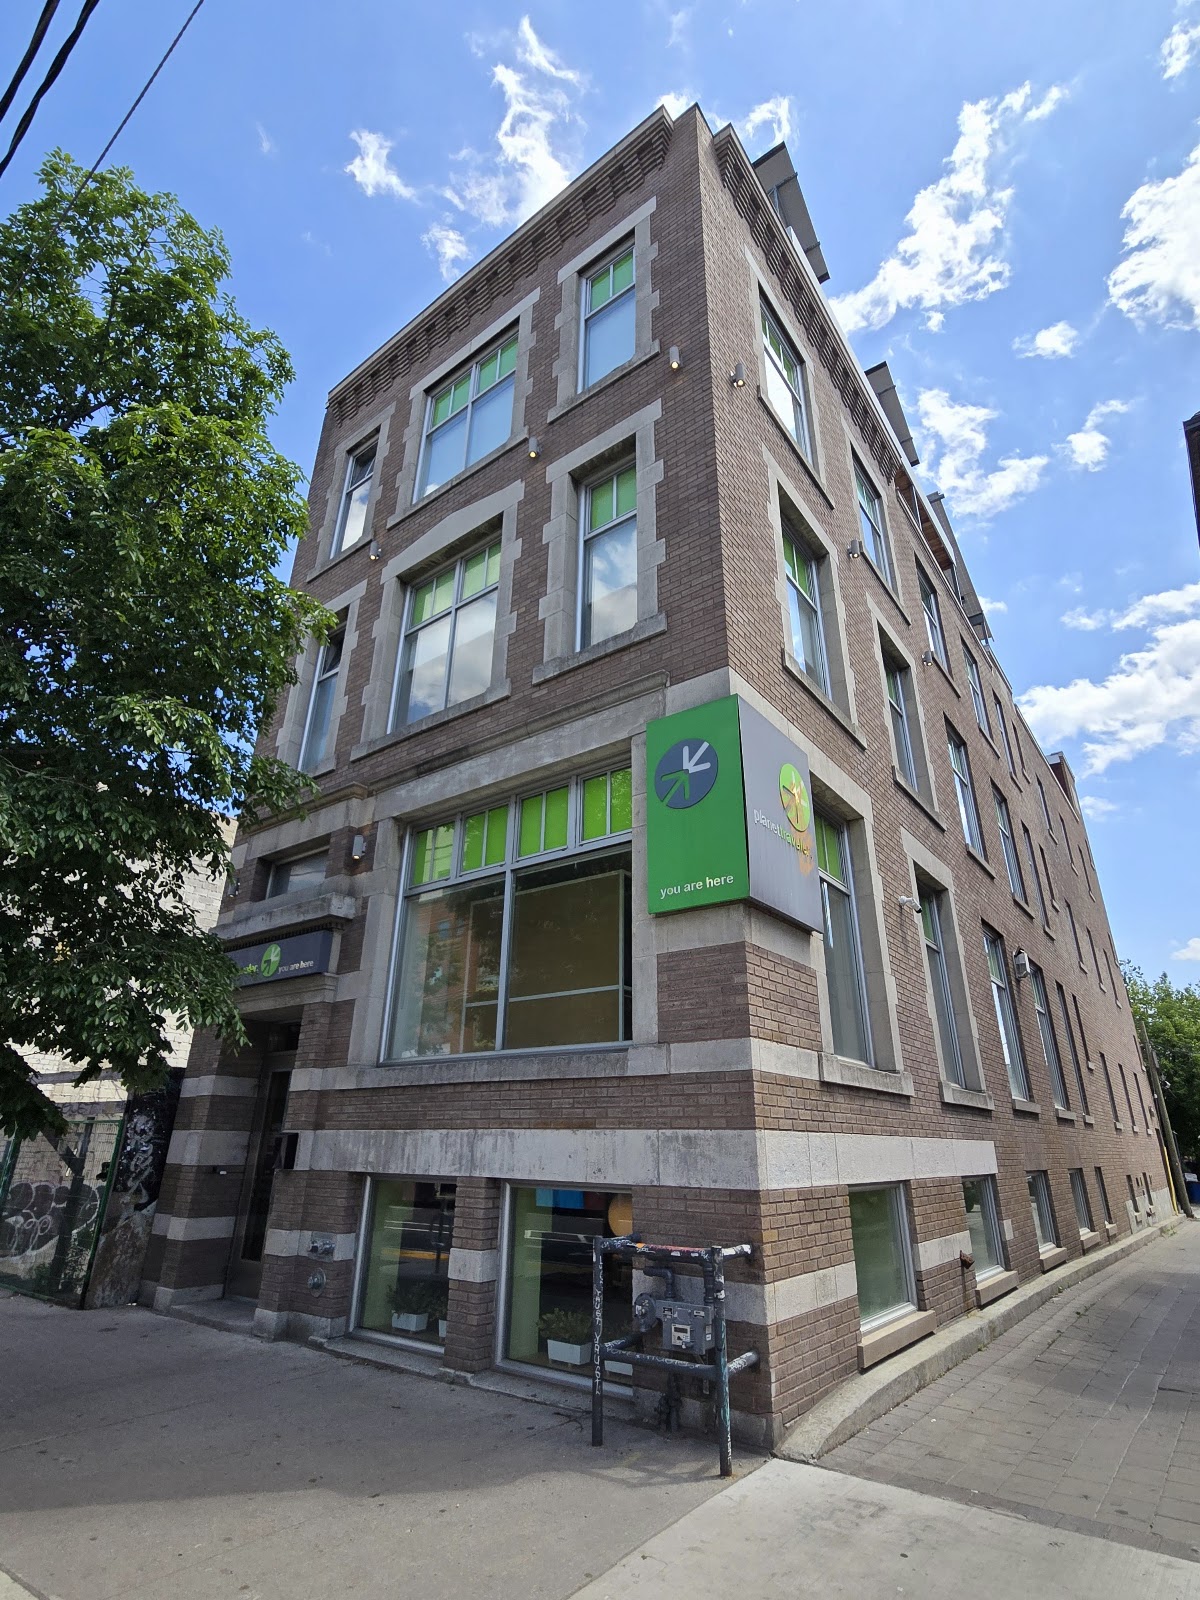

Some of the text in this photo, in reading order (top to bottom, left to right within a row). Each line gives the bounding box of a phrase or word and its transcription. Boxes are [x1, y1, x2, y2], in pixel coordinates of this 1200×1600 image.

[660, 874, 734, 899] you are here
[278, 960, 314, 974] you are here
